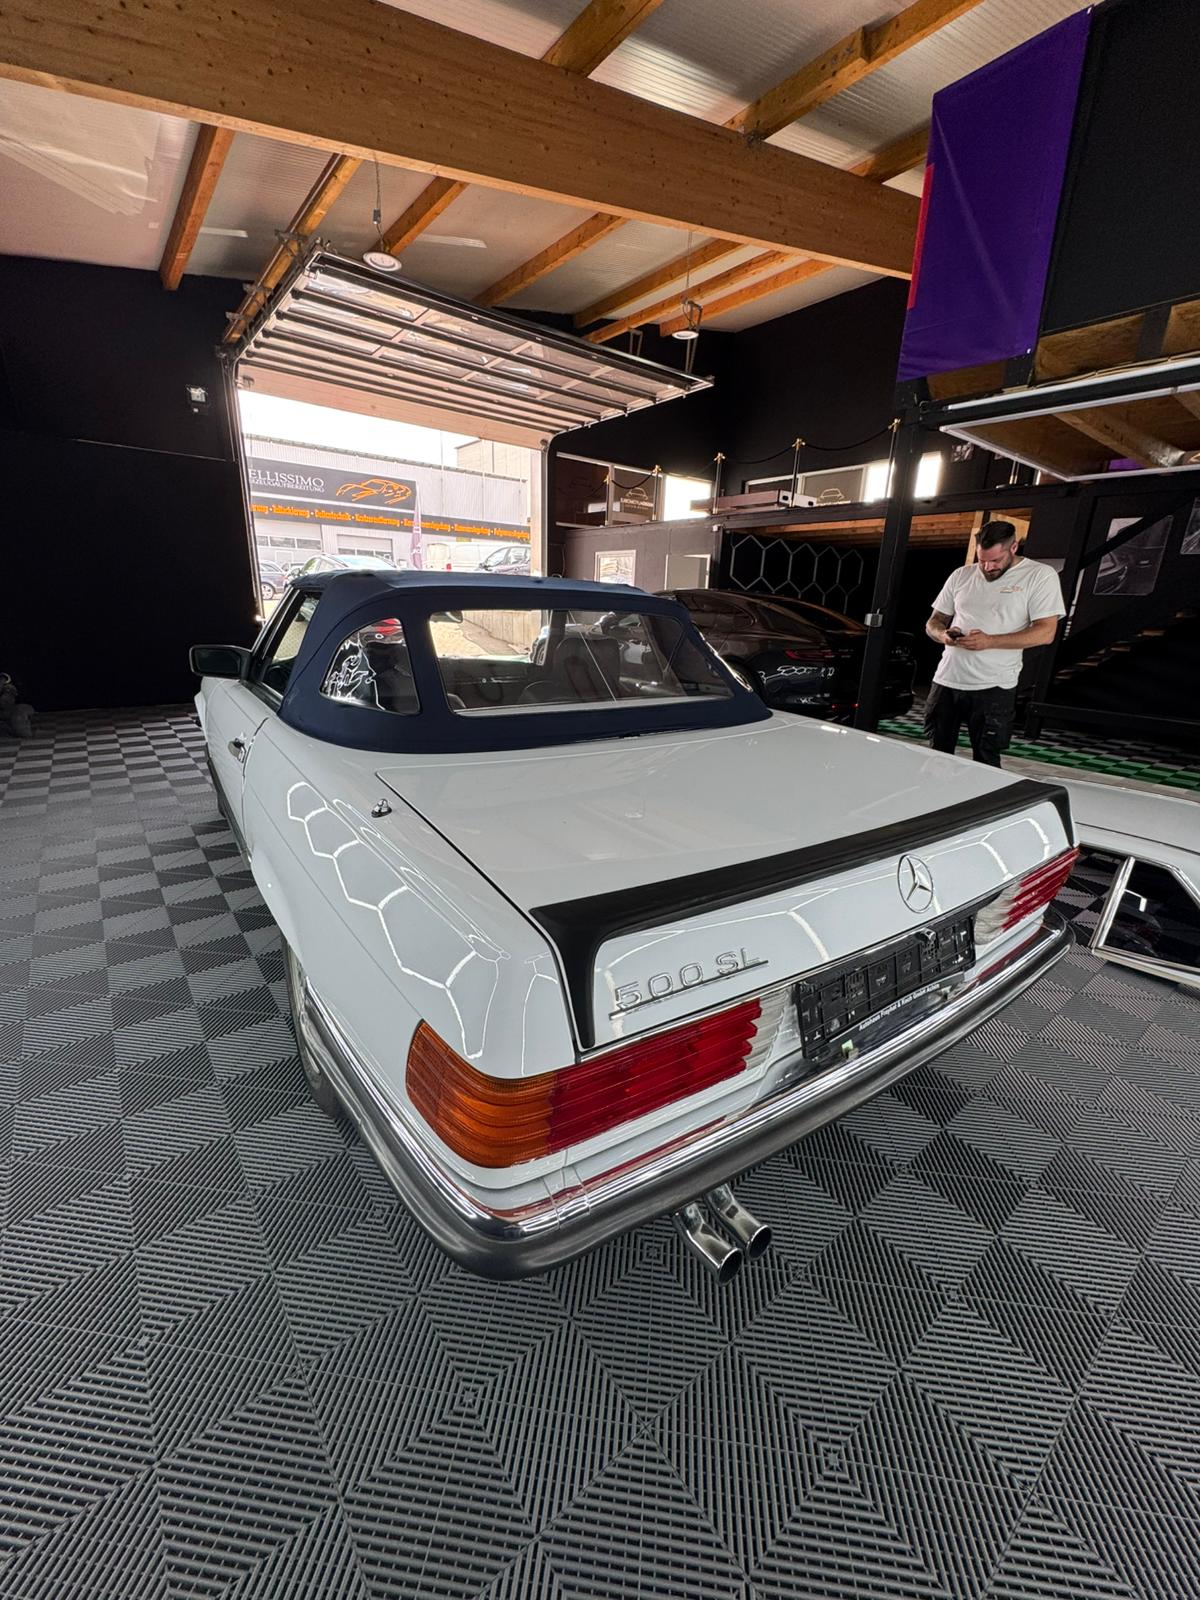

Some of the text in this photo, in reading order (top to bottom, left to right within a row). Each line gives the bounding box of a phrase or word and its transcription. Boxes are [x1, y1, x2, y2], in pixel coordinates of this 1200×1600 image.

[248, 468, 324, 487] ELLISSIMO
[615, 947, 760, 1010] 500 SL
